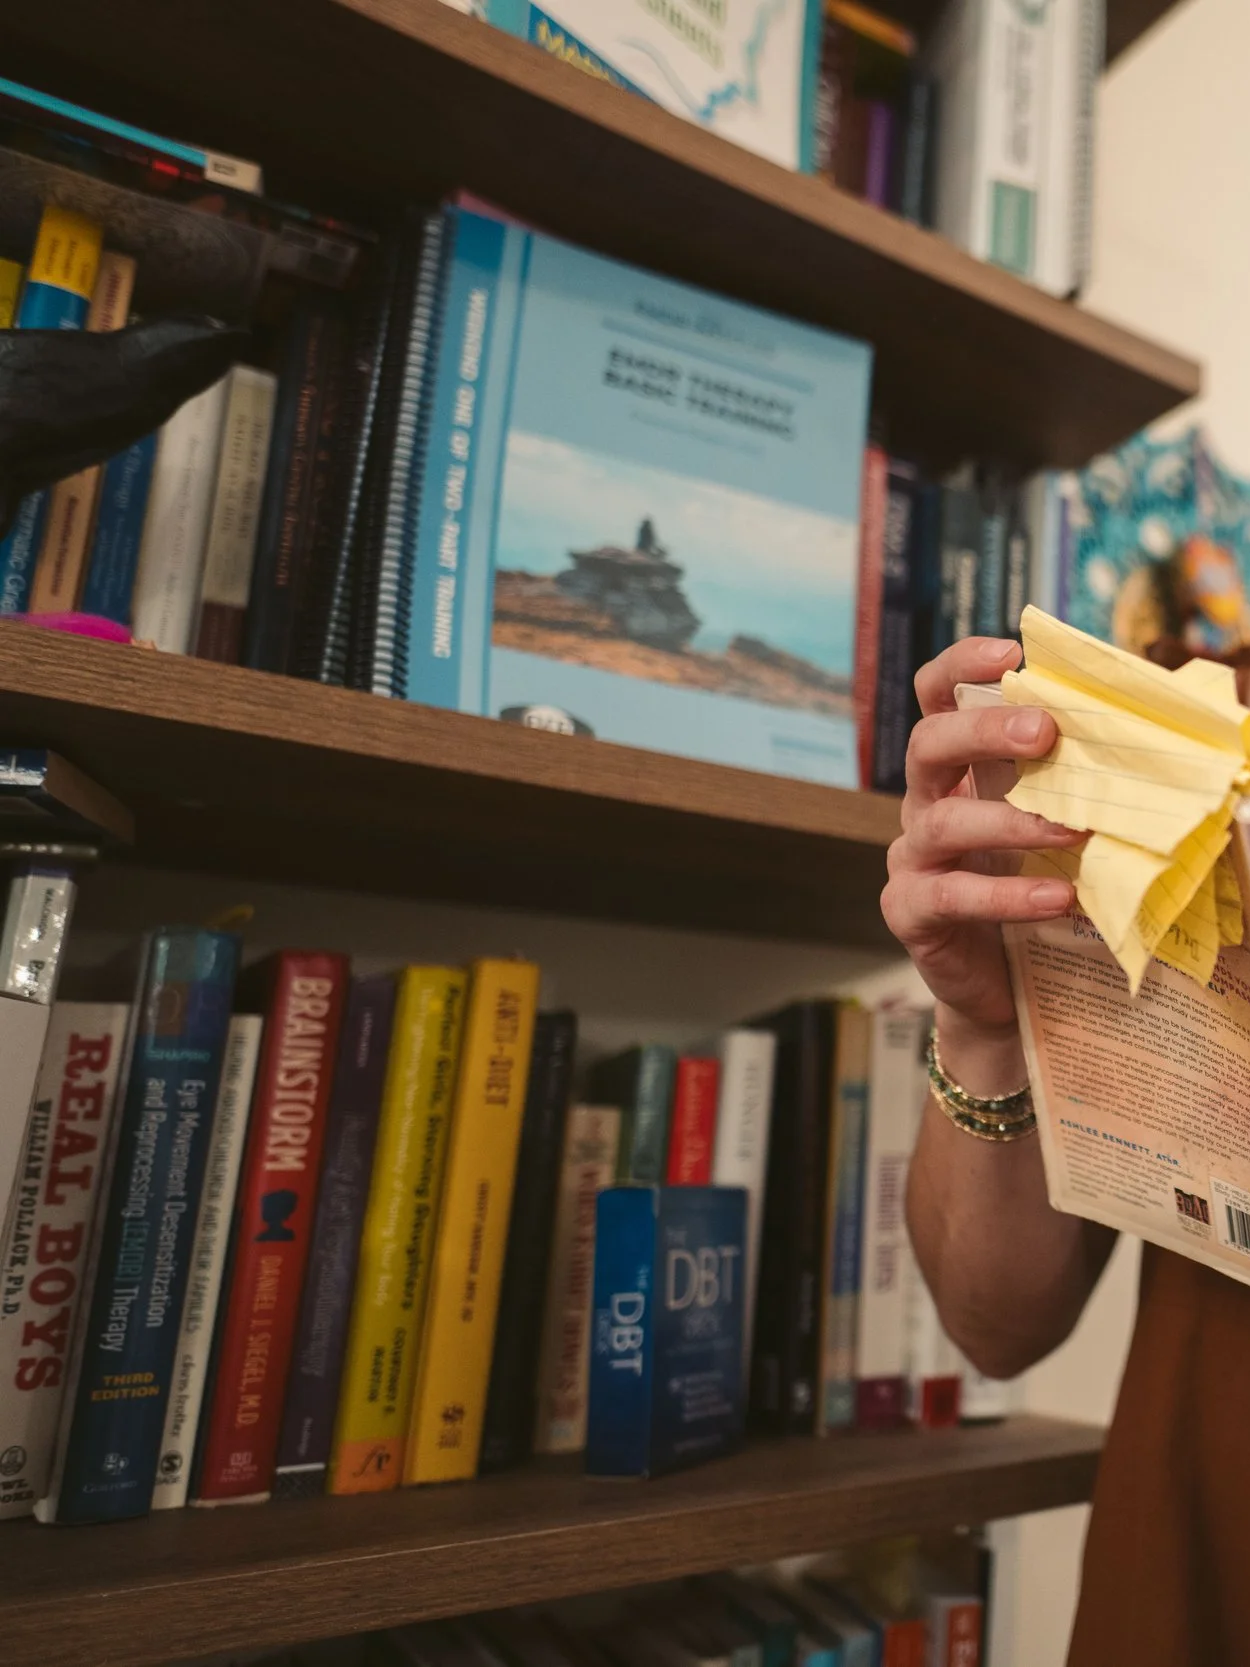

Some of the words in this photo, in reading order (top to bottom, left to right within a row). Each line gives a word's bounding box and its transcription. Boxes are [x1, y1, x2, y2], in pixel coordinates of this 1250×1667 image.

[459, 288, 489, 382] WEEKEND
[452, 384, 476, 428] ONE
[602, 369, 677, 407] BASIC
[684, 395, 796, 442] TRAINING
[608, 343, 682, 379] EMDR
[687, 371, 795, 417] THERAPY
[448, 428, 470, 461] OF
[437, 464, 467, 572] TWO-PART
[433, 573, 456, 660] TRAINING
[1078, 971, 1091, 981] and
[1140, 992, 1154, 1003] with
[1154, 999, 1169, 1010] your
[1171, 1003, 1188, 1018] body
[1189, 1011, 1207, 1028] using
[1145, 976, 1162, 988] Even
[1104, 1013, 1121, 1027] body
[1139, 1026, 1162, 1041] worthy
[1171, 1037, 1185, 1049] love
[1187, 1044, 1199, 1056] and
[1145, 1012, 1160, 1024] easy
[1179, 998, 1190, 1009] will
[1211, 1016, 1223, 1028] you
[262, 975, 334, 1171] BRAINSTORM
[1120, 1036, 1133, 1047] and
[1134, 1041, 1171, 1061] connection
[1172, 1055, 1187, 1068] with
[1188, 1064, 1203, 1077] your
[1204, 1070, 1221, 1086] body
[1223, 1079, 1236, 1092] and
[1132, 1032, 1145, 1042] and
[1178, 1048, 1197, 1065] guide
[1164, 1028, 1178, 1039] your
[1211, 1048, 1224, 1060] and
[44, 1032, 113, 1206] REAL
[144, 1077, 165, 1107] and
[177, 1078, 206, 1108] Eye
[24, 1099, 52, 1182] WILLIAM
[167, 1110, 200, 1198] Movement
[1060, 1118, 1099, 1137] ASHLEE
[121, 1109, 167, 1218] Reprocessing
[4, 1184, 38, 1272] POLLACK,
[146, 1201, 187, 1328] Desensitization
[253, 1254, 283, 1313] DANIEL
[665, 1244, 741, 1311] DBT
[1, 1274, 25, 1319] Ph.D.
[14, 1222, 84, 1391] BOYS
[100, 1284, 140, 1351] Therapy
[238, 1331, 272, 1392] SIEGEL,
[608, 1291, 646, 1377] DBT
[90, 1385, 160, 1402] EDITION
[103, 1372, 155, 1387] THIRD
[234, 1393, 263, 1429] M.D.
